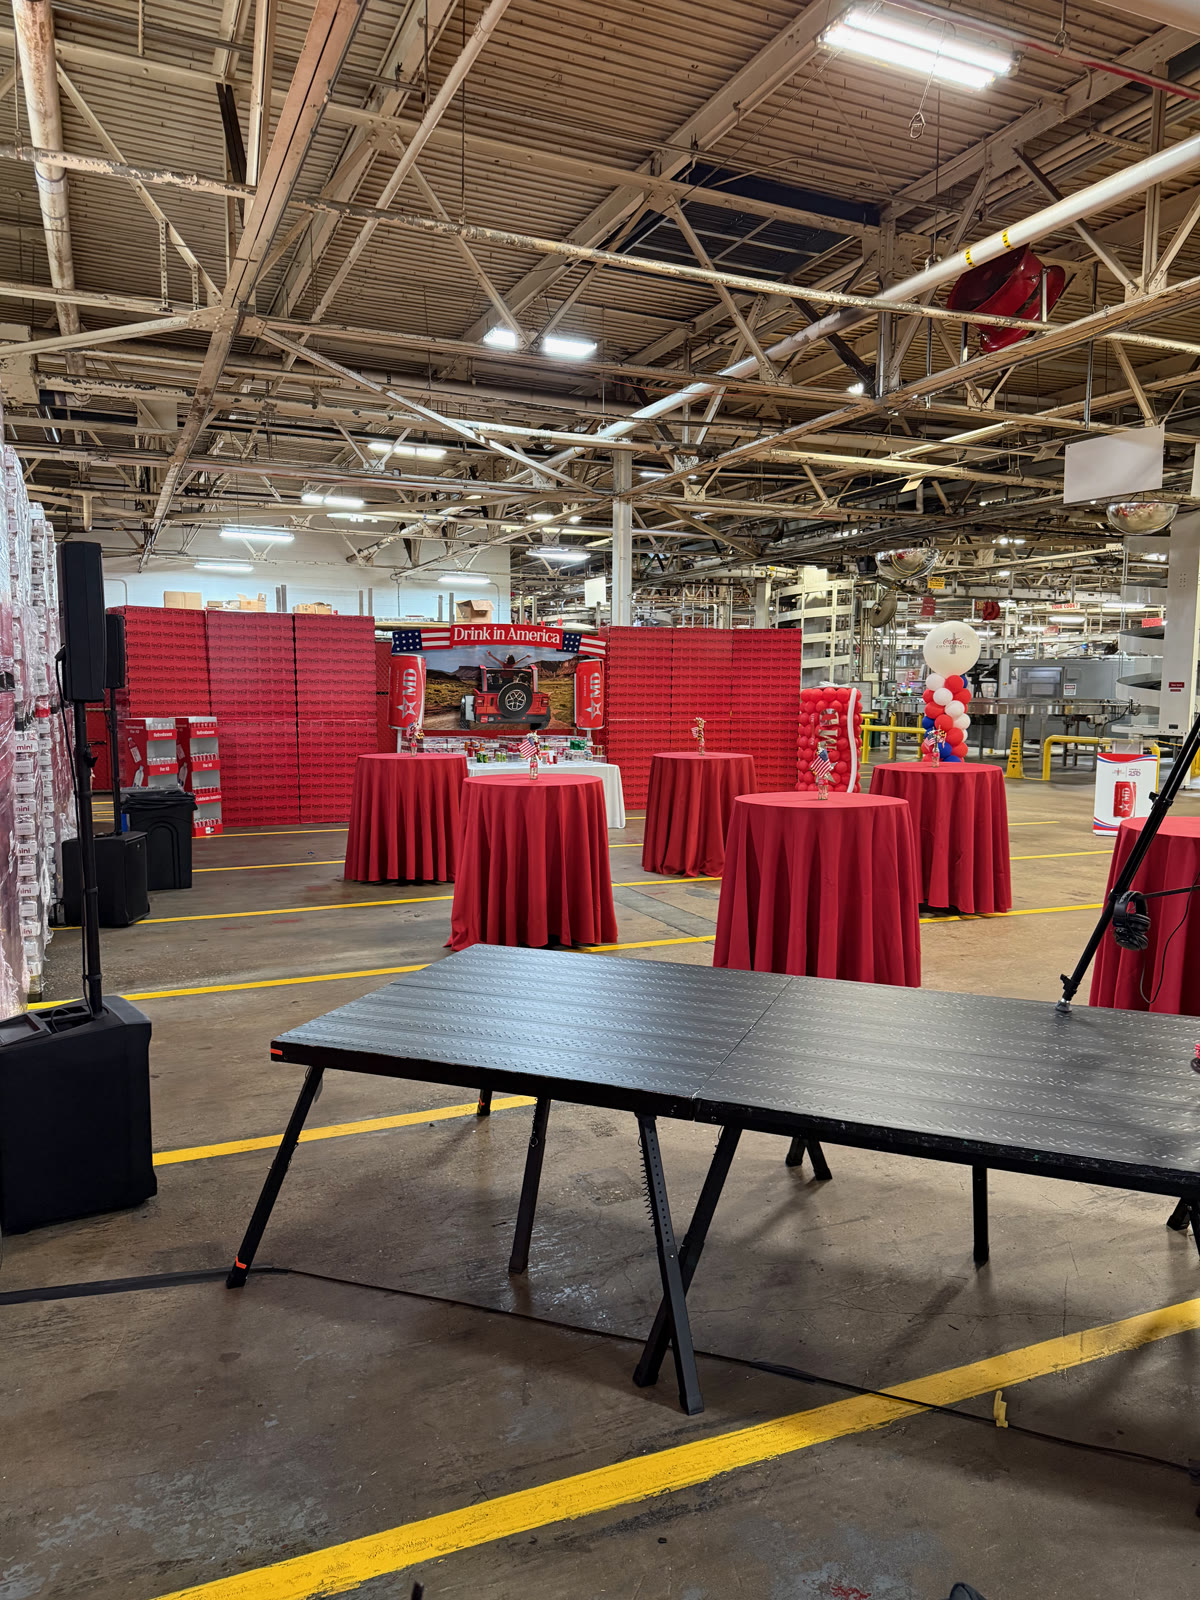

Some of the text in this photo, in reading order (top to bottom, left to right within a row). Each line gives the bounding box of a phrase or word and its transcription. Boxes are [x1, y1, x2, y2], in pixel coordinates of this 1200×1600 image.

[453, 626, 560, 644] Drink in America
[402, 668, 417, 696] MD
[590, 672, 601, 698] MD
[818, 708, 840, 750] MD
[16, 743, 33, 751] mini
